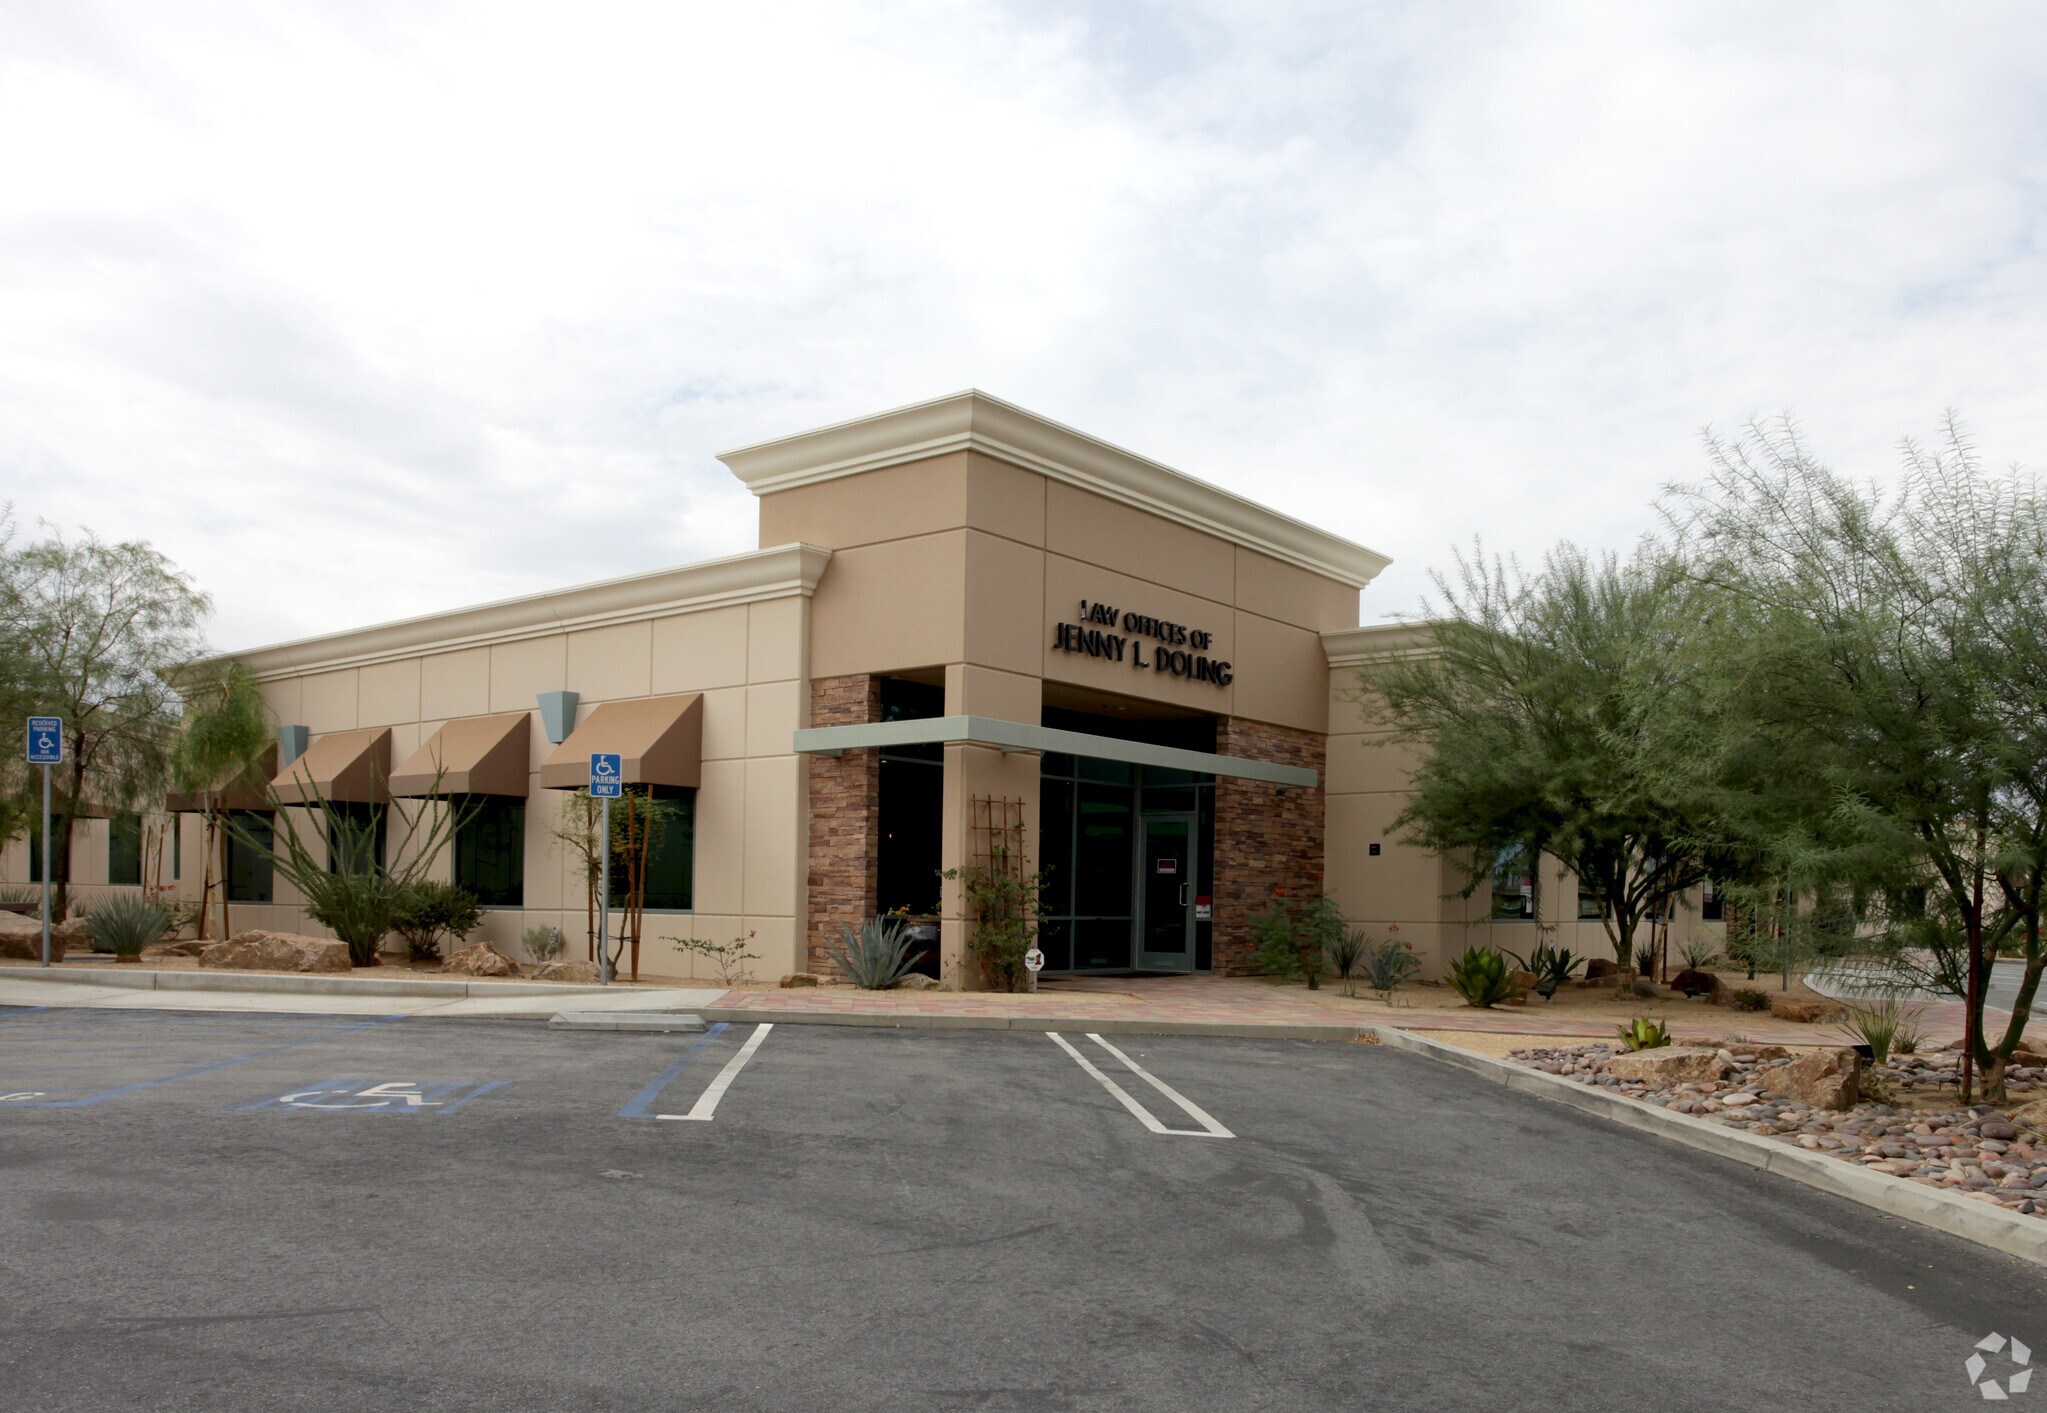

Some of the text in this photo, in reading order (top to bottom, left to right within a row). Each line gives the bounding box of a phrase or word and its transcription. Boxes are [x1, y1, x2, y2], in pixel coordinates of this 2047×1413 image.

[1080, 600, 1213, 650] LAW OFFICES OF
[1053, 622, 1128, 662] JENNY
[1156, 646, 1234, 687] DOLING
[591, 775, 620, 784] PARKING
[597, 785, 614, 794] ONLY
